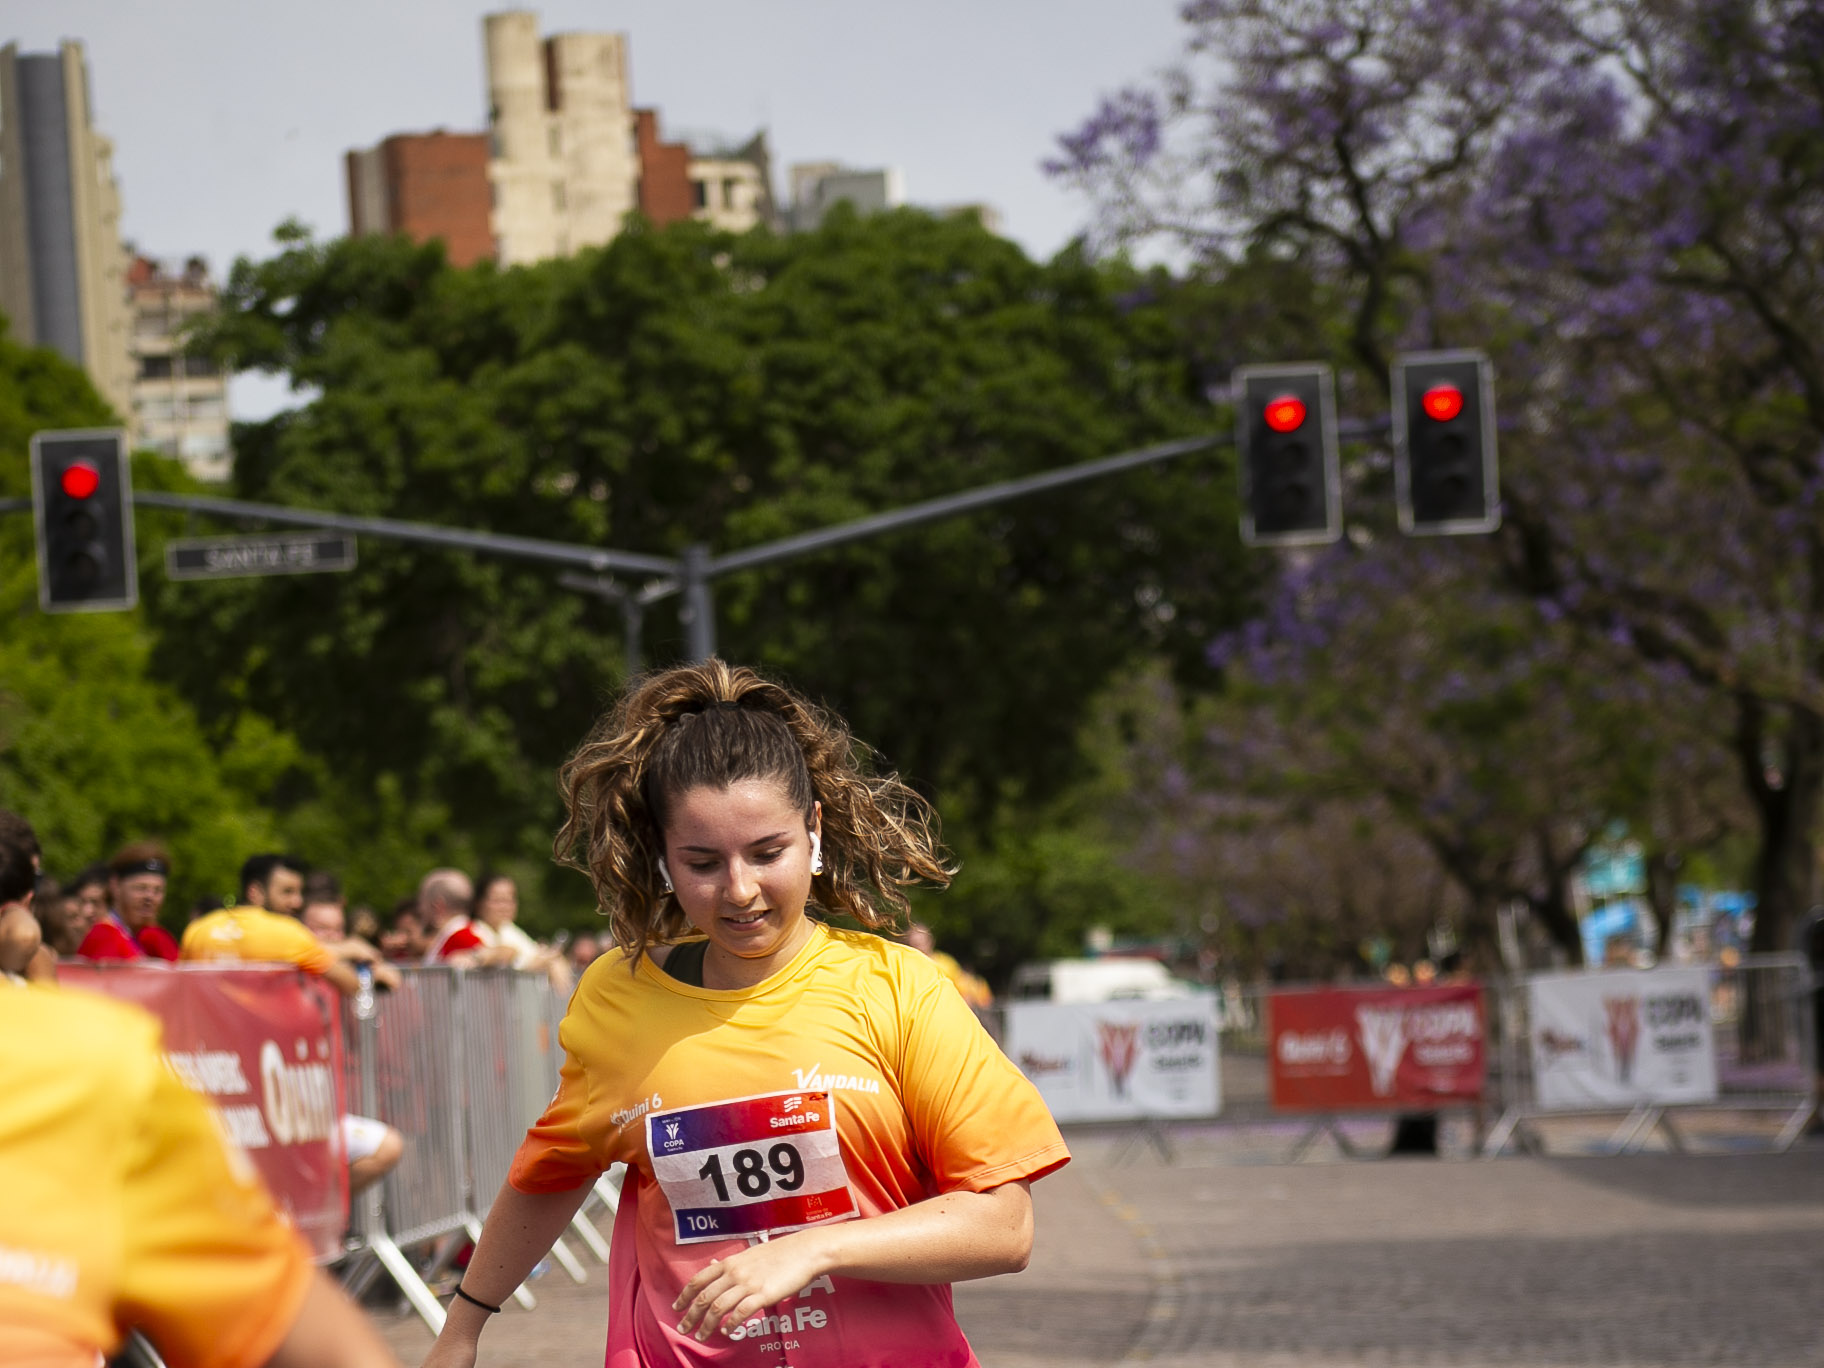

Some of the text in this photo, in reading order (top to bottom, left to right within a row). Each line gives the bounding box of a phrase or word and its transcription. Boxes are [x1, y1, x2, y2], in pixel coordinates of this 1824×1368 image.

[791, 1062, 880, 1094] VANDALIA
[619, 1092, 663, 1125] Quini 6
[769, 1111, 820, 1128] Santa Fe
[663, 1138, 685, 1149] COPA
[698, 1142, 805, 1202] 189
[686, 1215, 719, 1231] 10k
[794, 1306, 828, 1331] Fe
